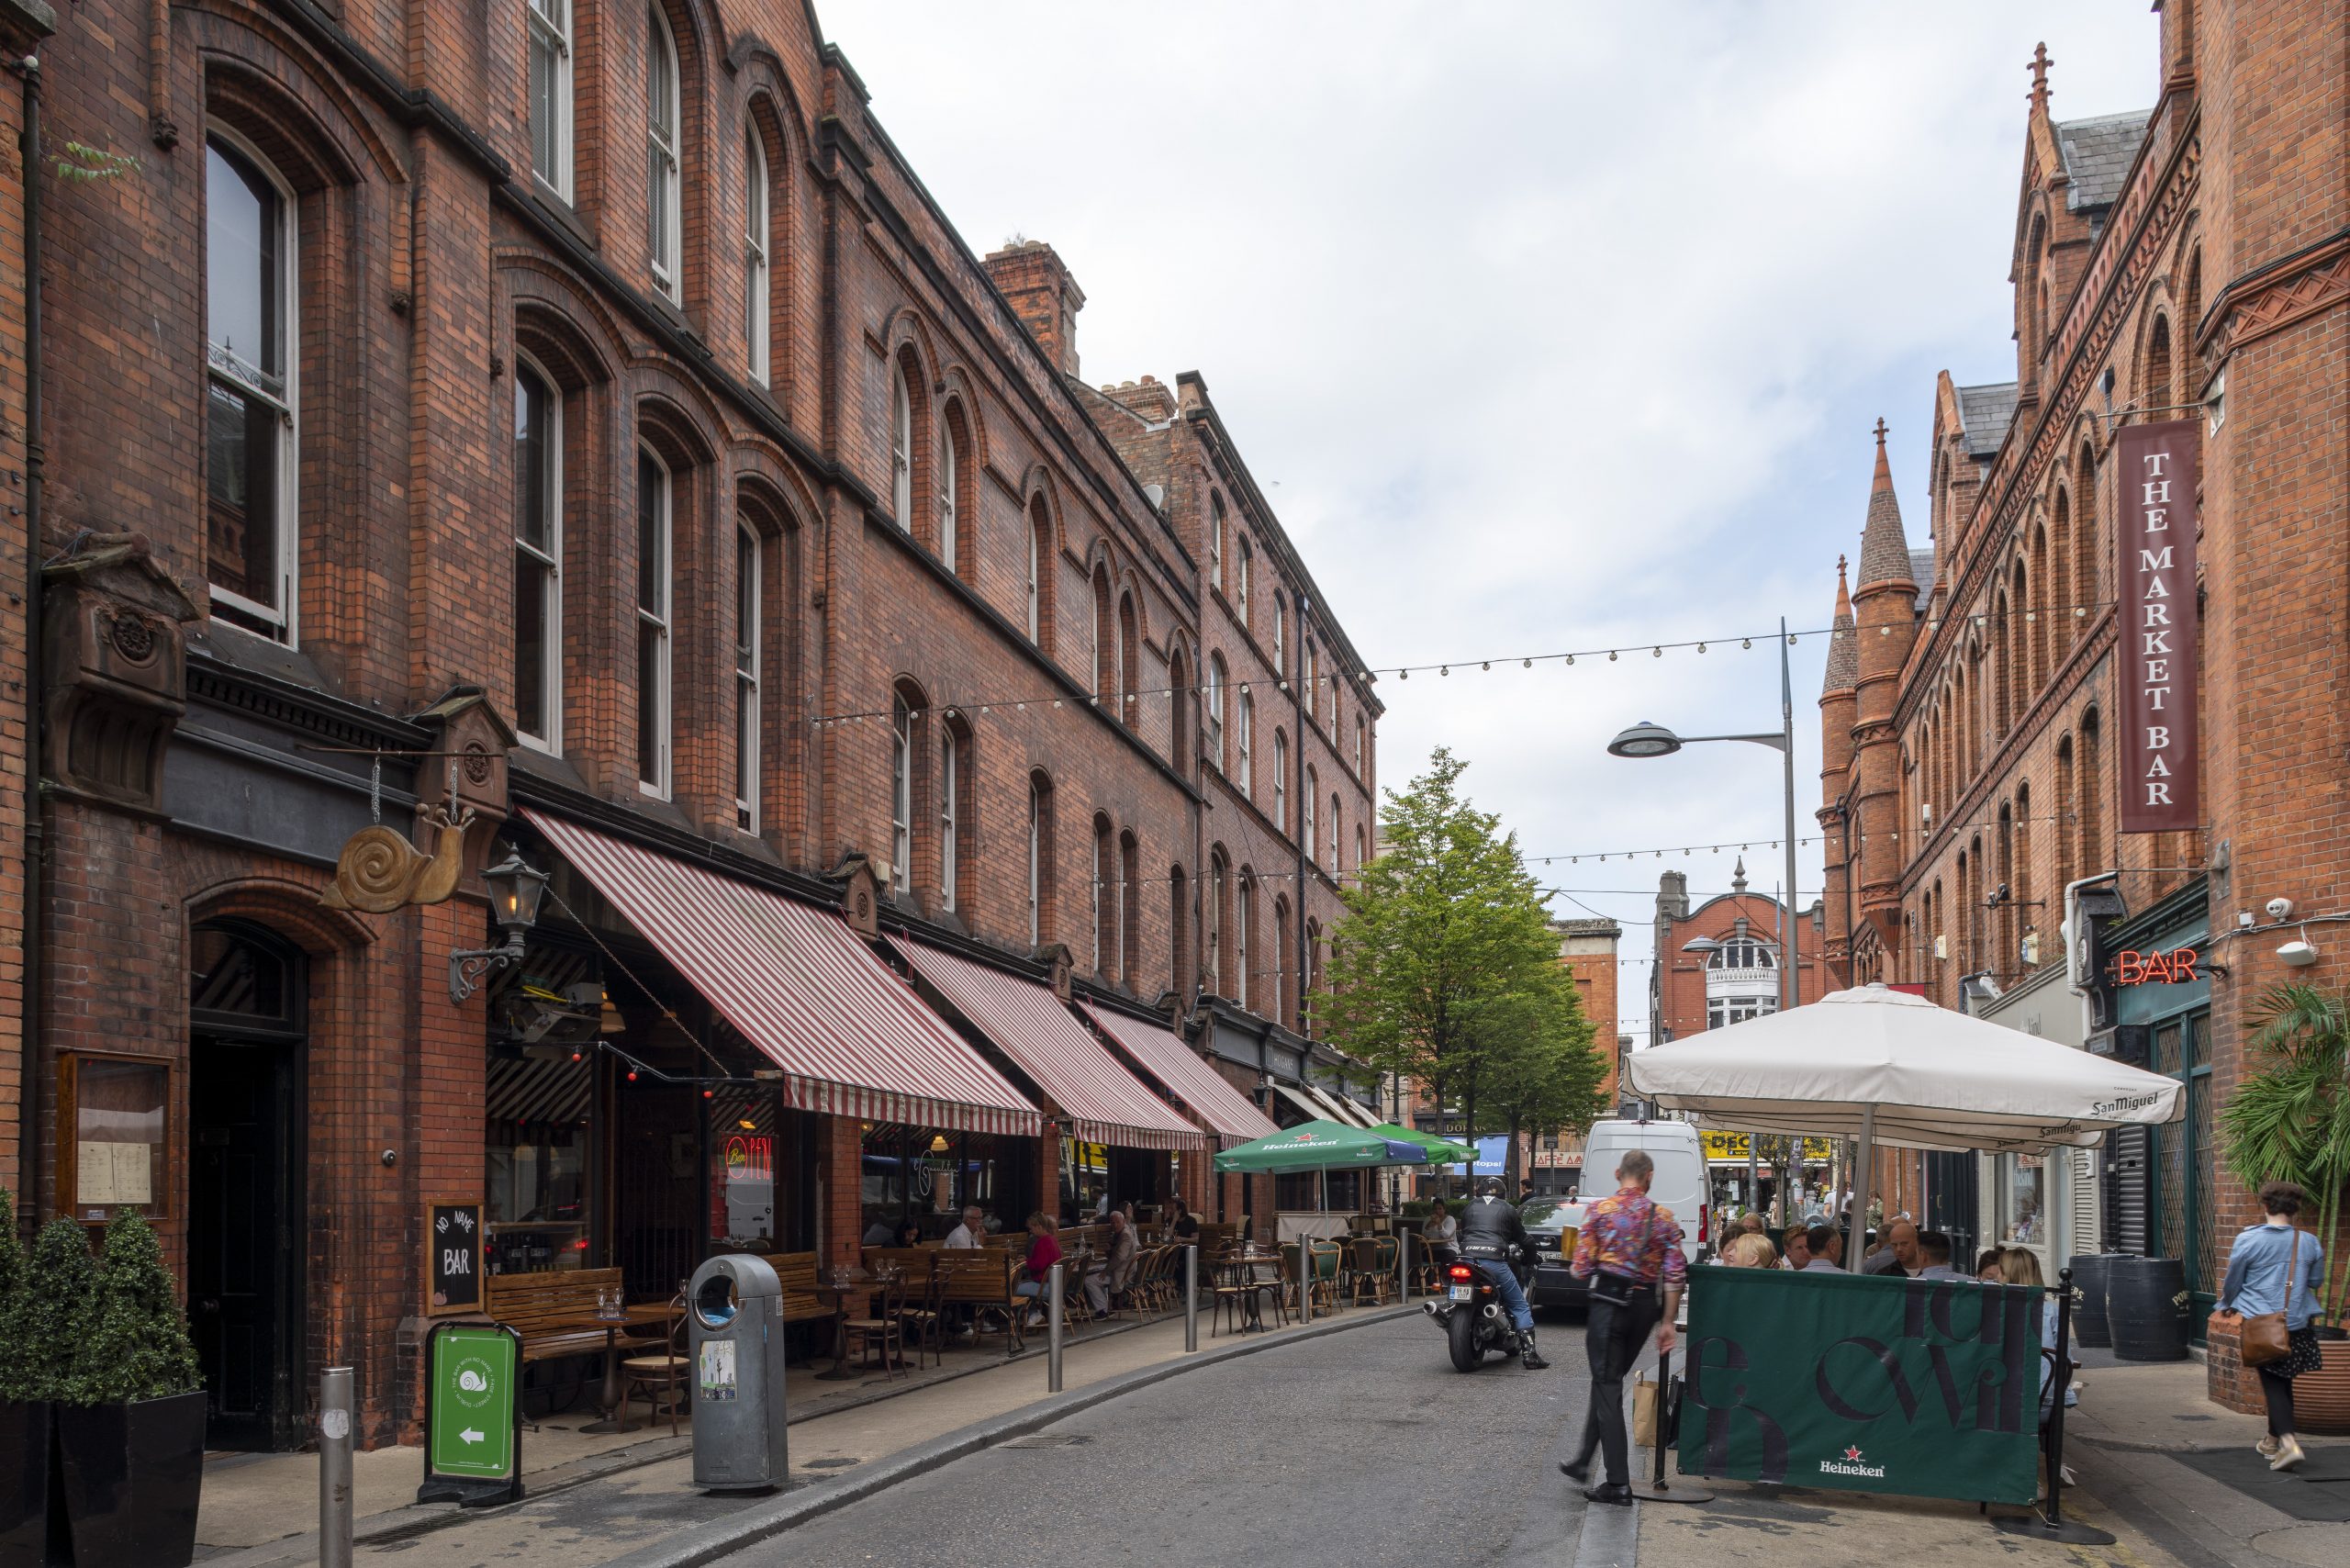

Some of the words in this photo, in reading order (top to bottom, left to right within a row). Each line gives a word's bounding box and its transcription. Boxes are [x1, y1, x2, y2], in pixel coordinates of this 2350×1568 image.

[2142, 453, 2171, 532] THE
[2139, 546, 2174, 710] MARKET
[2145, 726, 2173, 806] BAR
[2120, 948, 2198, 983] BAR
[726, 1136, 771, 1180] OPEN
[1262, 1140, 1338, 1150] Heineken
[435, 1216, 449, 1234] NO
[454, 1210, 475, 1234] NAME
[443, 1249, 470, 1275] BAR
[1819, 1461, 1885, 1477] Heineken
